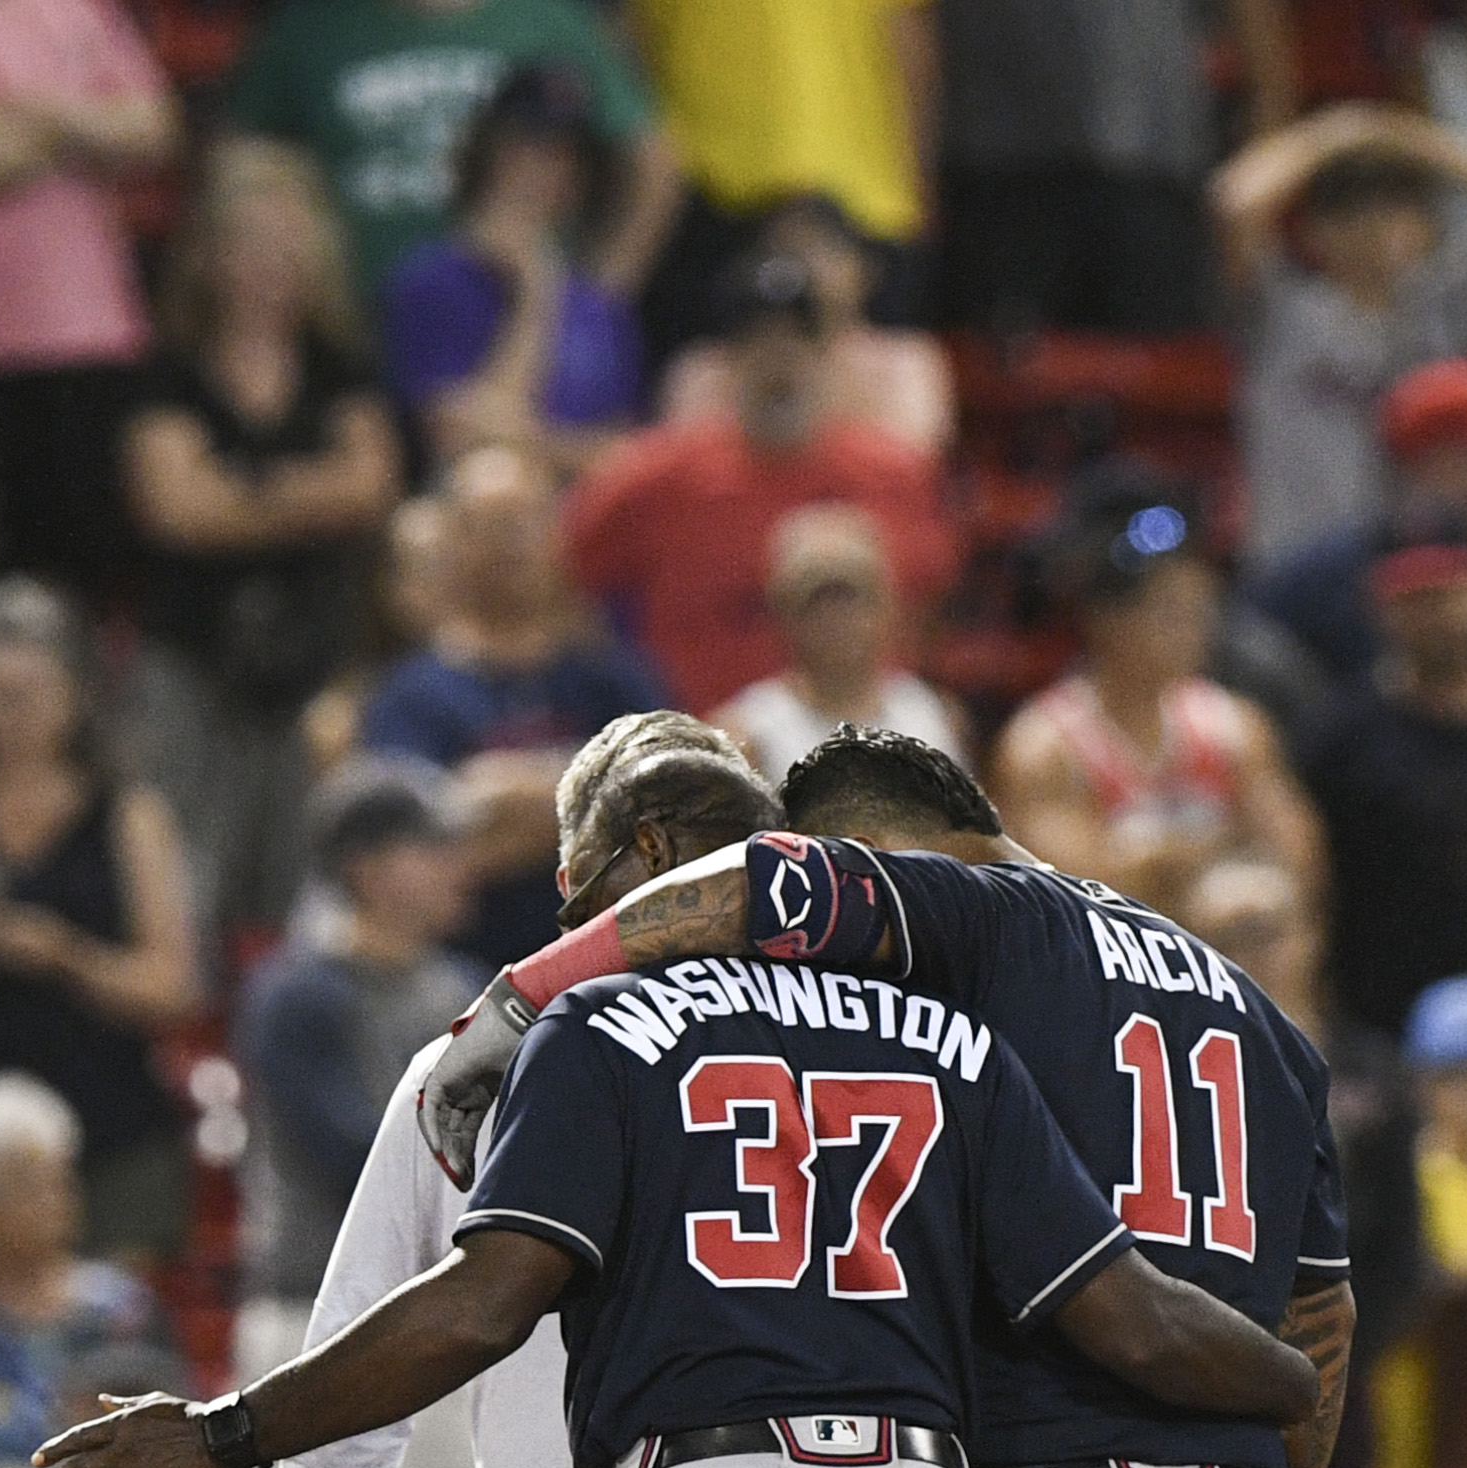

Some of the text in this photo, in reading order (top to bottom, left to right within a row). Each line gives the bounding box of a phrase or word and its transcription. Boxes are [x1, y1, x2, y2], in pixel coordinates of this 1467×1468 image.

[587, 957, 992, 1083] WASHINGTON
[1087, 910, 1247, 1014] ARCIA
[678, 1055, 944, 1299] 37
[1113, 1012, 1256, 1263] 11
